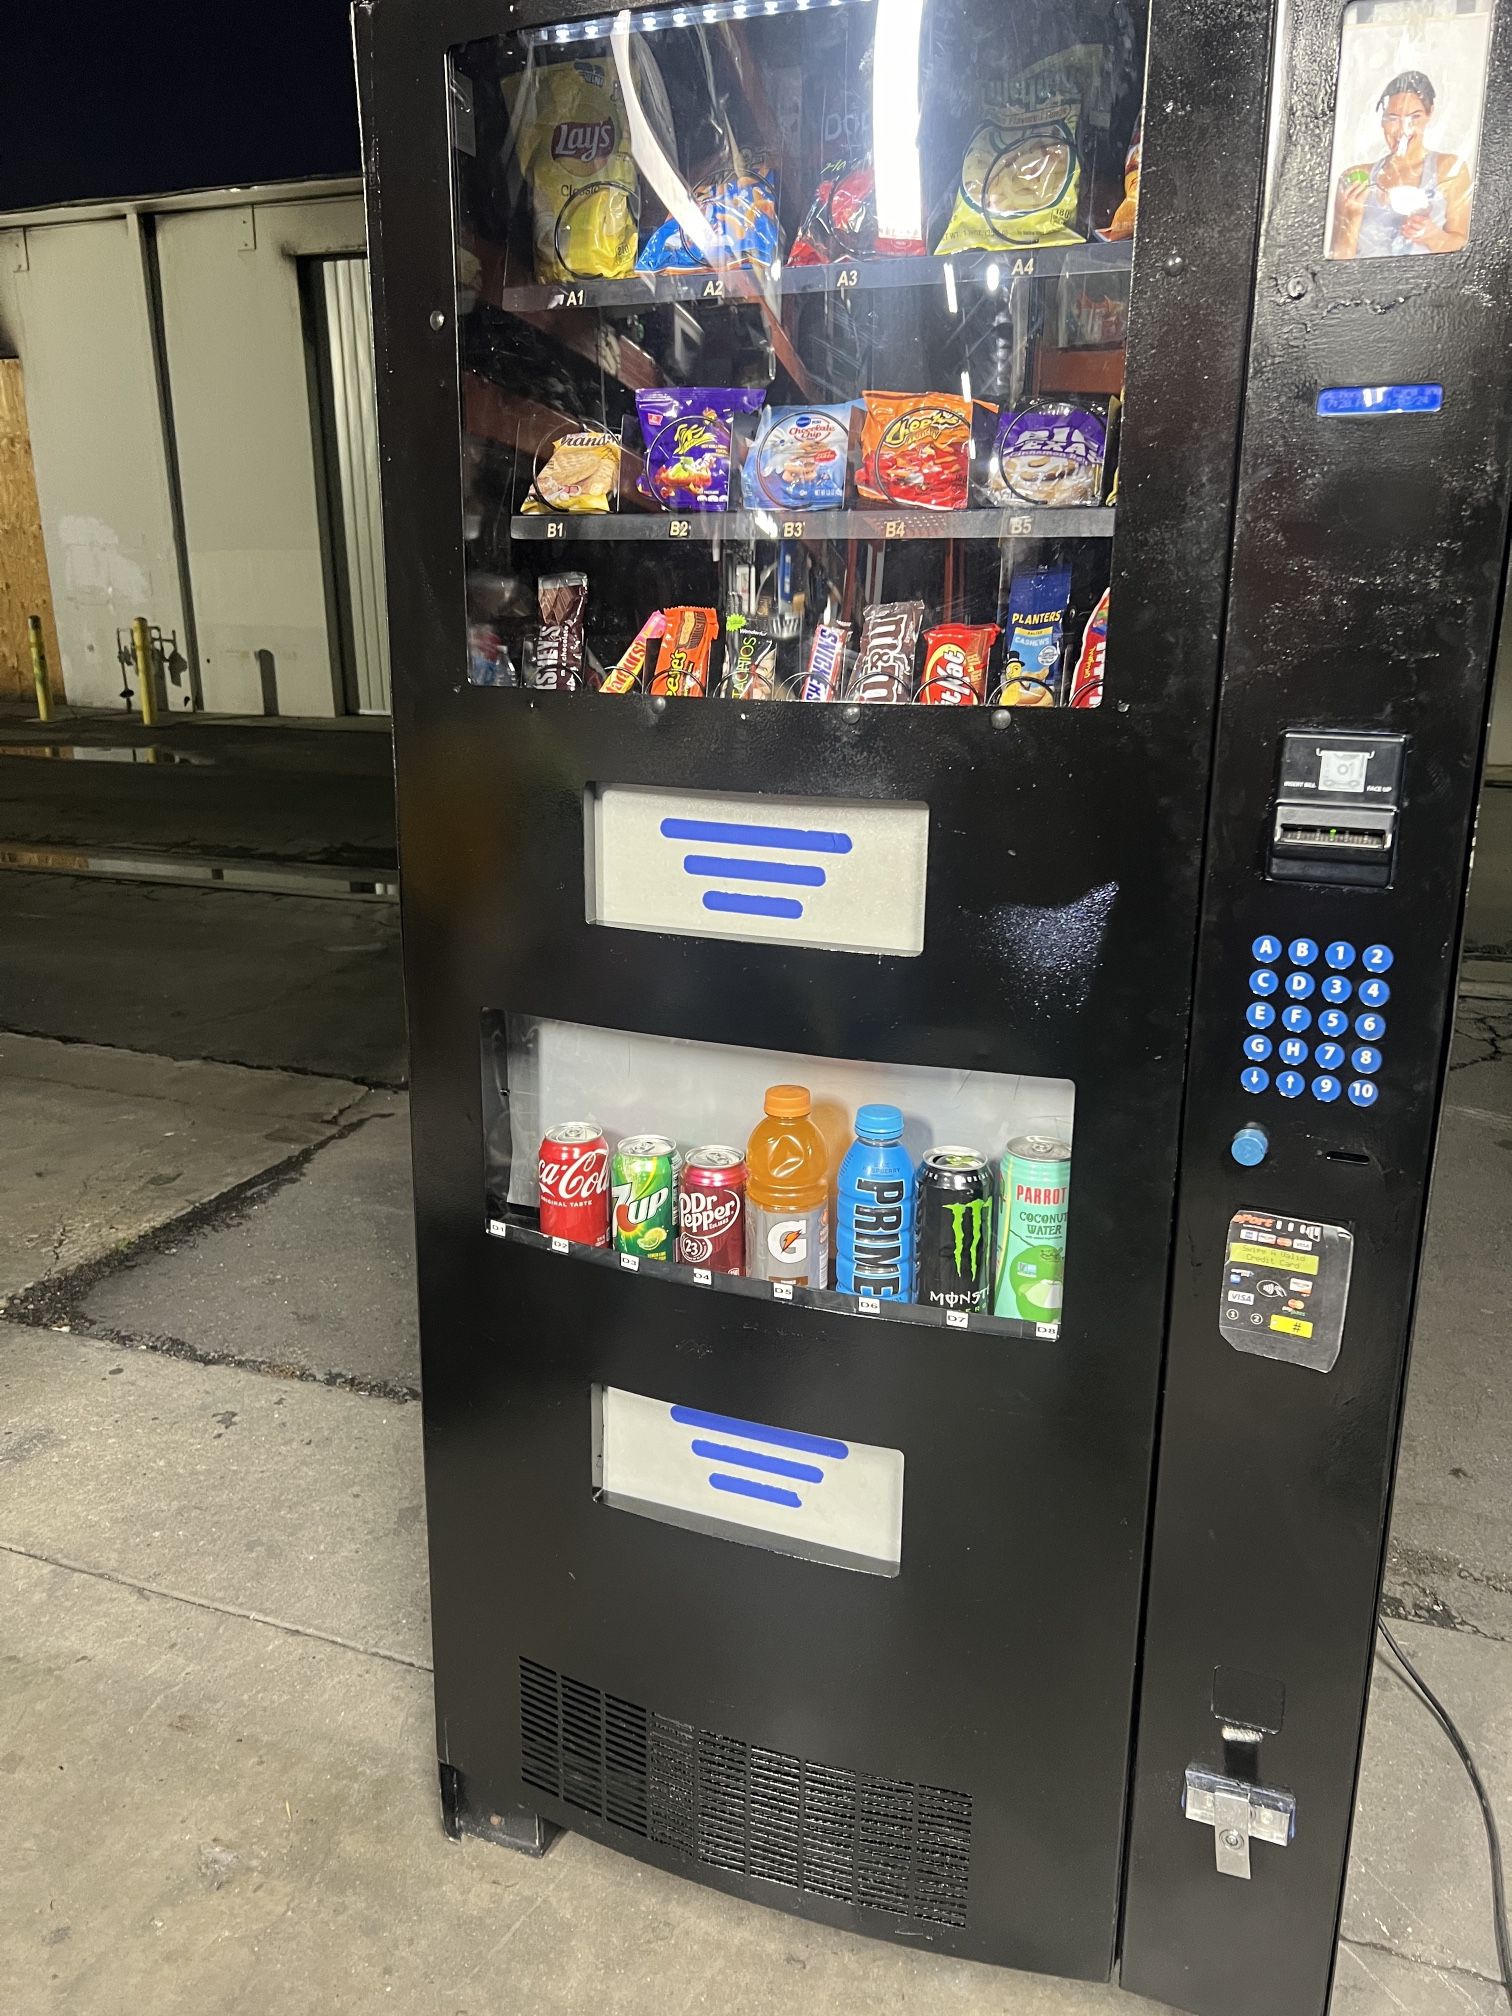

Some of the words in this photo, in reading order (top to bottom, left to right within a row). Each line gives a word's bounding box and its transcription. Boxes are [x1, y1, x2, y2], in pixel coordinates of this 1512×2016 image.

[1012, 258, 1034, 275] A4
[837, 270, 858, 287] A3
[704, 282, 723, 297] A2
[566, 290, 584, 307] A1
[547, 522, 563, 538] B1
[669, 521, 689, 537] B2
[784, 521, 804, 537] B3
[885, 521, 905, 538] B4
[1010, 517, 1032, 534] B5
[1012, 610, 1063, 625] PLANTERS
[561, 625, 569, 660] chocolate
[1015, 637, 1050, 647] CASHEWS
[1259, 940, 1273, 954] A
[1296, 942, 1309, 957] B
[1336, 945, 1344, 960] 1
[1371, 949, 1383, 963] 2
[1257, 973, 1270, 987] C
[1292, 976, 1306, 990] D
[1330, 979, 1342, 994] 3
[1367, 983, 1379, 998] 4
[1255, 1005, 1265, 1020] E
[1290, 1009, 1302, 1023] F
[1327, 1013, 1339, 1027] 5
[1364, 1017, 1375, 1031] 6
[1251, 1038, 1264, 1052] G
[1286, 1042, 1299, 1056] H
[1324, 1046, 1335, 1060] 7
[1360, 1050, 1372, 1065] 8
[1320, 1078, 1332, 1093] 9
[1353, 1083, 1373, 1098] 10
[1016, 1184, 1068, 1205] PARROT
[569, 1199, 593, 1209] TASTE
[691, 1193, 718, 1213] Dr
[1019, 1211, 1069, 1225] COCONUT
[491, 1223, 505, 1233] D1
[1027, 1224, 1062, 1236] WATER
[767, 1219, 807, 1264] G
[852, 1178, 906, 1297] PRIME
[685, 1239, 699, 1256] 23
[622, 1257, 637, 1266] D3
[694, 1272, 710, 1280] D4
[774, 1287, 792, 1295] D5
[1232, 1293, 1252, 1302] VISA
[860, 1301, 878, 1309] D6
[947, 1314, 966, 1323] D7
[1037, 1326, 1056, 1335] D8
